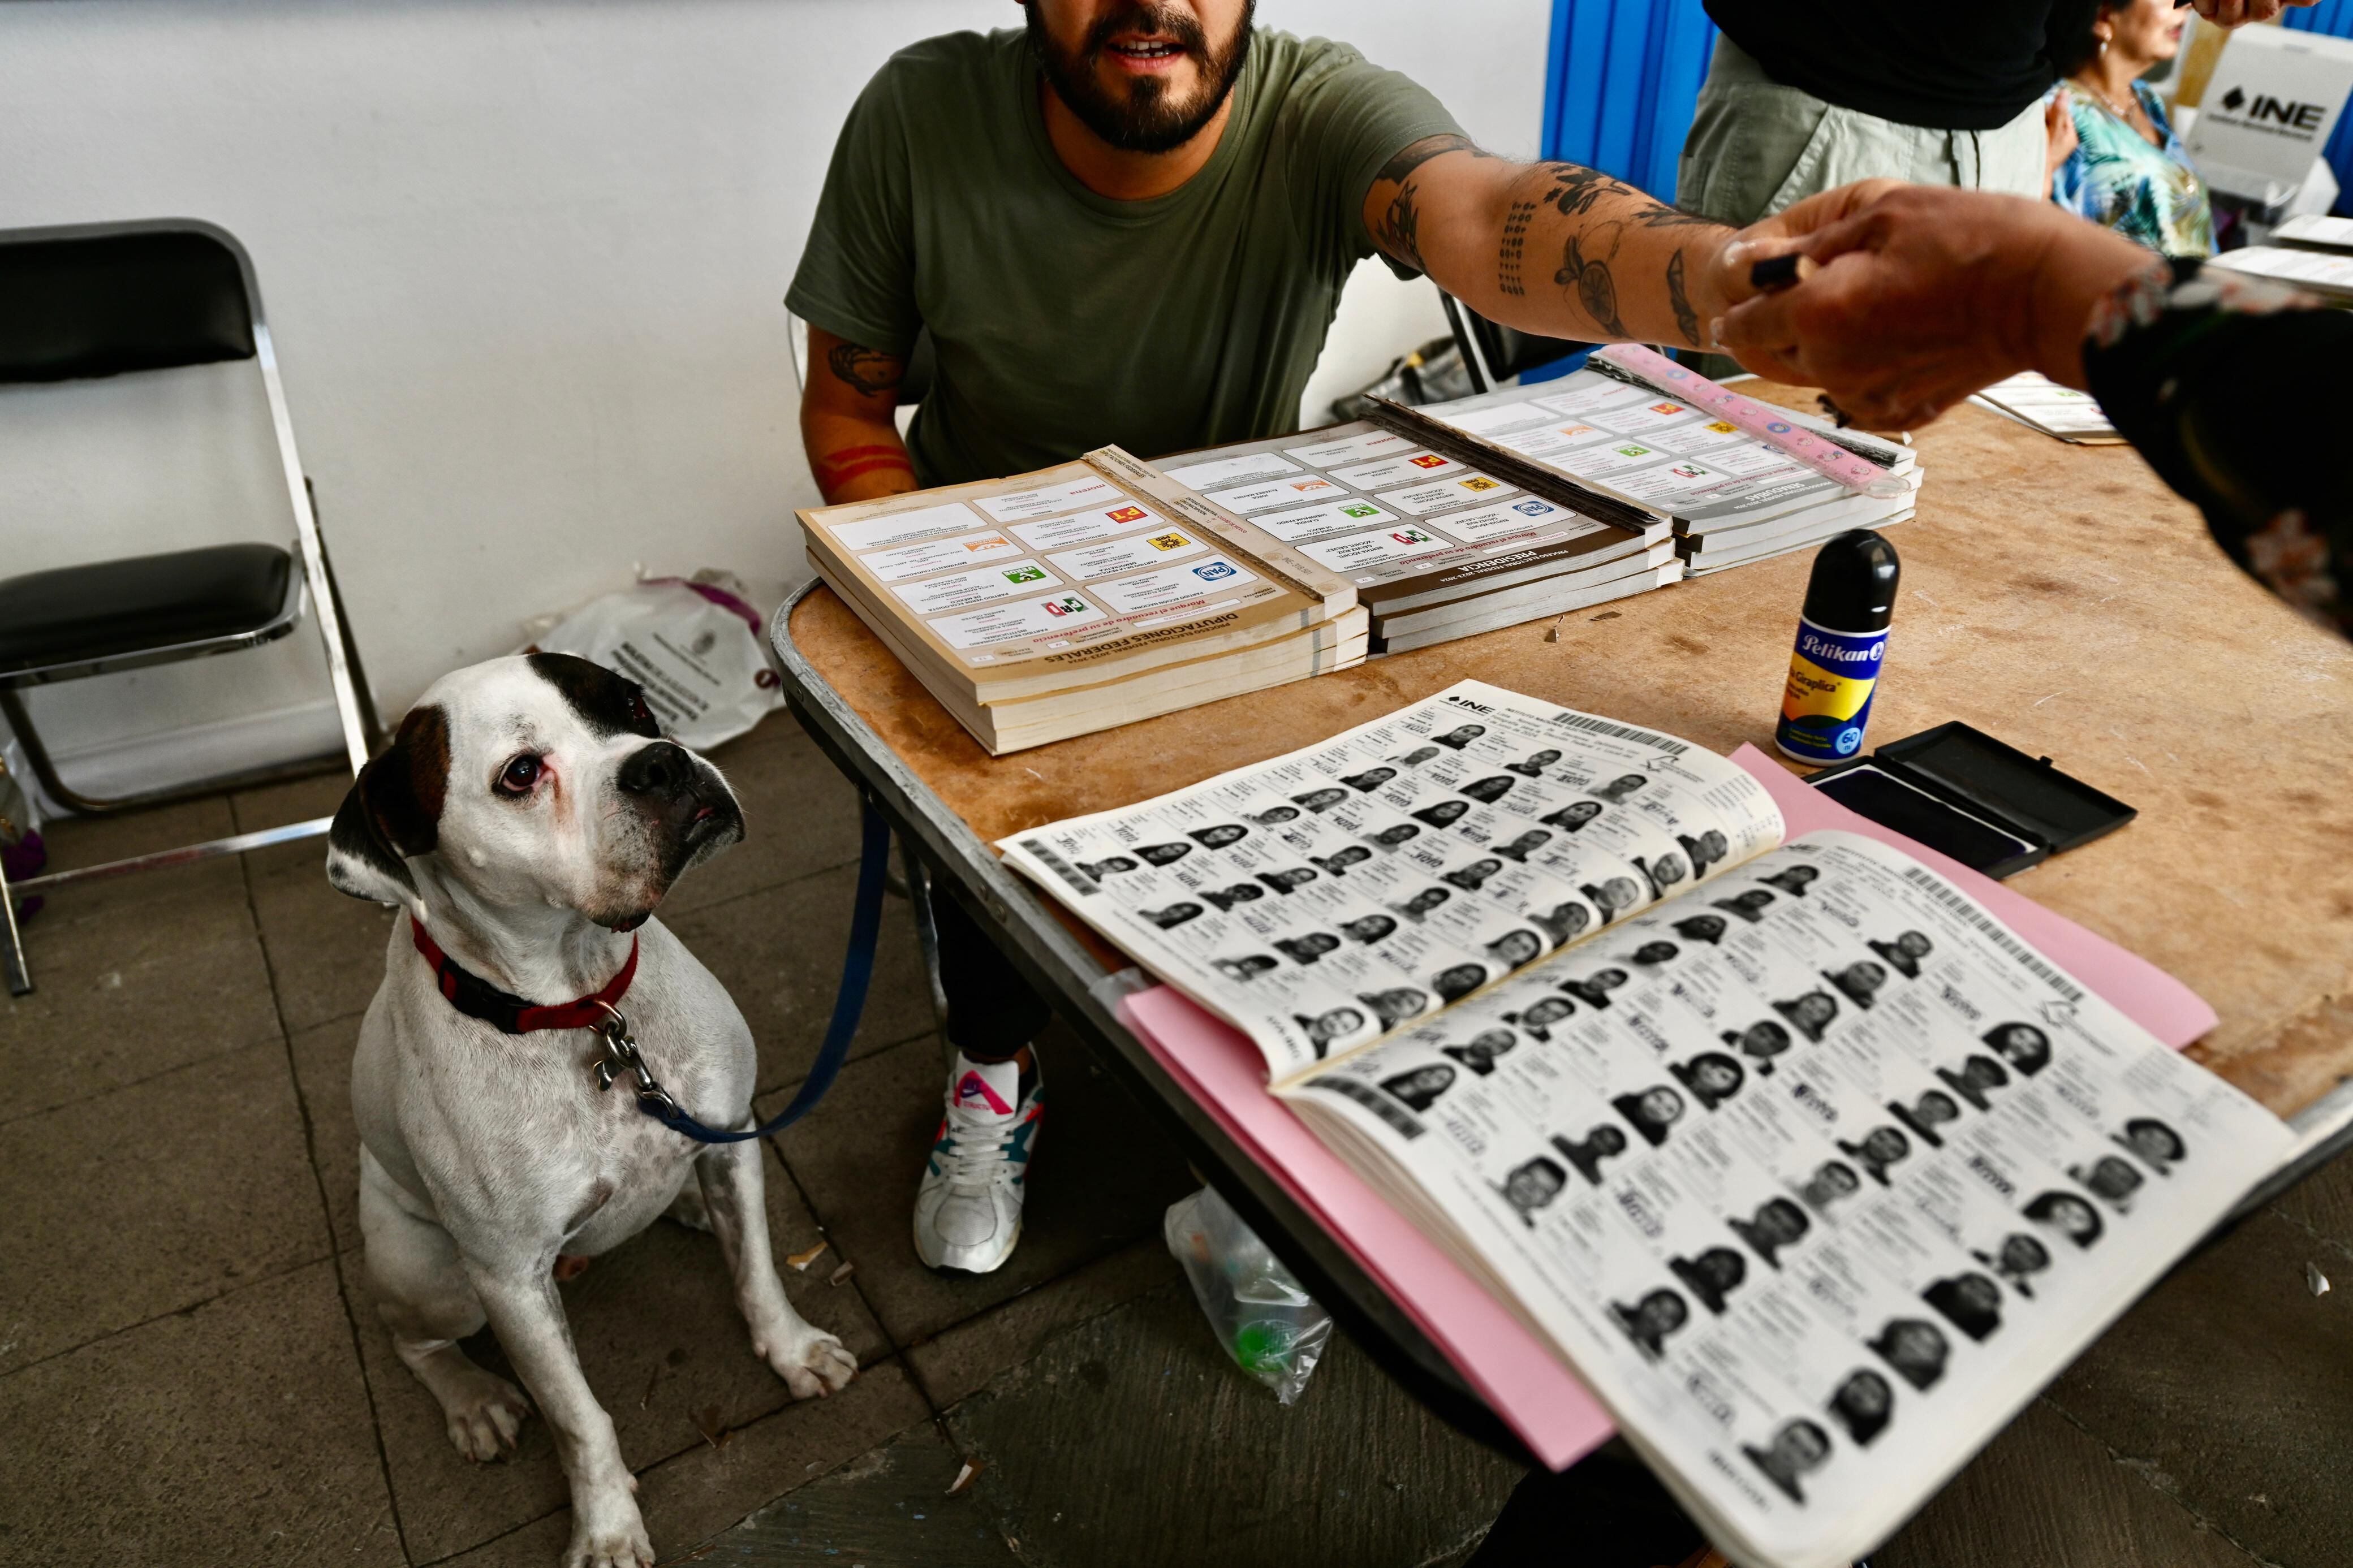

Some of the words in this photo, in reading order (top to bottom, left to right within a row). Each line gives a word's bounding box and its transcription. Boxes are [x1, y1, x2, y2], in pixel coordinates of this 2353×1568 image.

[2249, 94, 2326, 131] INE
[1412, 455, 1441, 465] PT
[1068, 484, 1106, 495] morena
[1109, 507, 1141, 520] PT
[1506, 531, 1537, 540] Marque
[1464, 540, 1501, 550] recuadro
[1398, 551, 1445, 565] preferencia
[1540, 550, 1569, 559] PROCESO
[930, 561, 967, 571] MOVIMIENTO
[1458, 550, 1538, 572] PRESIDENCIA
[1475, 561, 1503, 573] FEDERAL
[1504, 555, 1539, 567] ELECTORAL
[896, 569, 931, 578] CIUDADANO
[1002, 566, 1035, 575] VERDE
[1201, 567, 1227, 576] PAN
[1440, 569, 1475, 582] 2023-2024
[927, 602, 964, 611] ECOLOGISTA
[1129, 602, 1159, 610] NACIONAL
[1165, 599, 1207, 611] Marque
[1115, 610, 1160, 623] recuadro
[1129, 613, 1241, 642] DIPUTACIONES
[1193, 623, 1232, 633] PROCESO
[968, 633, 1021, 646] REVOLUCIONARIO
[982, 629, 1028, 640] INSTITUCIONAL
[1032, 627, 1091, 644] preferencia
[1147, 631, 1195, 643] ELECTORAL
[1044, 638, 1131, 663] FEDERALES
[1113, 641, 1150, 653] FEDERAL
[1802, 634, 1869, 662] Pelikan
[1067, 651, 1110, 663] 2023-2024
[1459, 700, 1496, 714] INE
[1505, 708, 1534, 719] INSTITUTO
[1535, 716, 1563, 728] NACIONAL
[1565, 725, 1597, 737] ELECTORAL
[1842, 732, 1858, 744] 60
